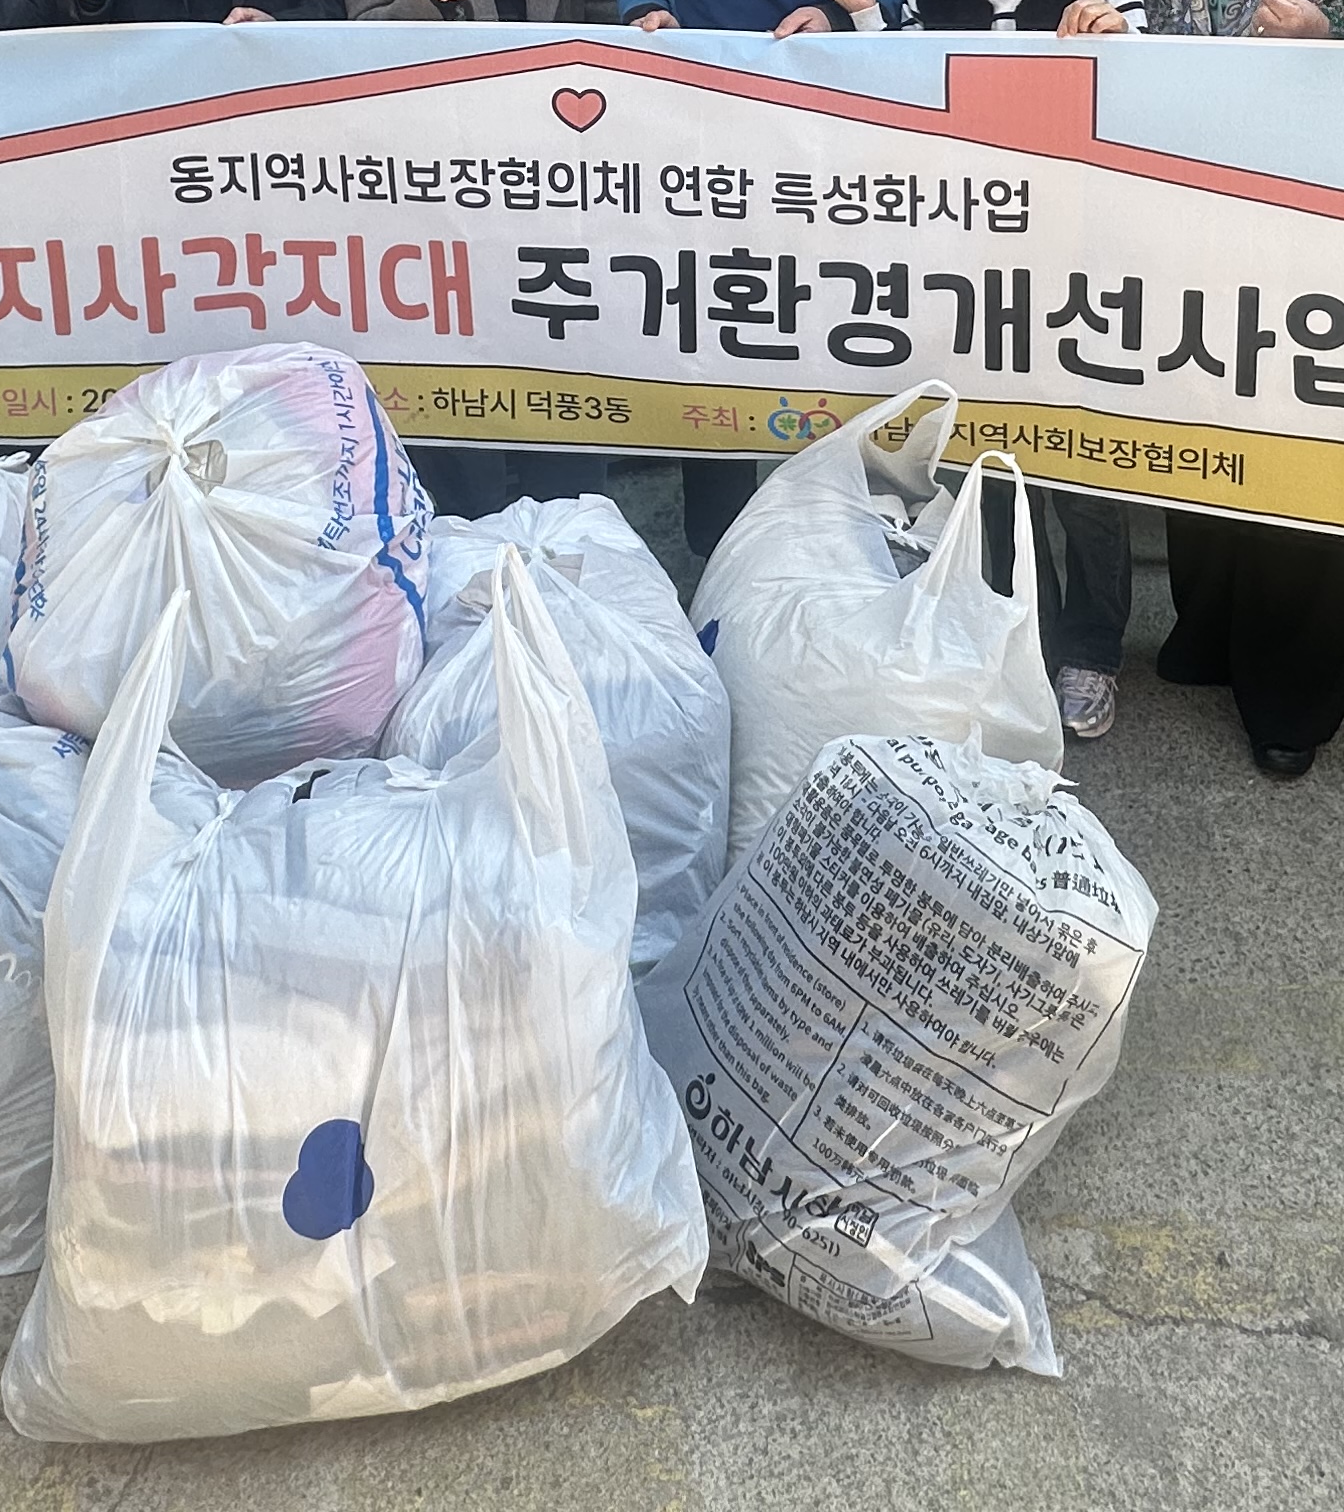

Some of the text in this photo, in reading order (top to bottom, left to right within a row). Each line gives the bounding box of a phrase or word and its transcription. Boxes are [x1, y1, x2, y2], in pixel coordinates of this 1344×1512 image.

[169, 151, 1033, 235] 동지역사회보장협의체 연합 특성화사업
[1, 384, 58, 419] 일시
[81, 385, 118, 418] 20
[373, 383, 411, 412] 소
[430, 385, 519, 420] 하남시
[524, 387, 634, 425] 덕풍3동
[680, 400, 742, 434] 주최
[765, 840, 939, 1008] 100만원 이하의 과태료가 부과됩니다.
[810, 819, 853, 865] 불가능한
[846, 855, 885, 895] 불연성
[956, 944, 1007, 988] 도자기,
[864, 798, 898, 833] 다음날
[917, 843, 968, 889] 6시까지
[963, 879, 1013, 924] 내집앞,
[1010, 914, 1082, 969] 내상가앞에
[933, 833, 1016, 901] 일반쓰레기만
[1080, 936, 1101, 957] 후
[768, 868, 798, 905] 봉투는
[790, 896, 820, 933] 하남시
[813, 925, 841, 954] 지역
[837, 946, 894, 998] 내에서만
[889, 990, 962, 1049] 사용하여야
[957, 1038, 1001, 1070] 합니다.
[810, 870, 835, 899] 다른
[828, 890, 857, 920] 봉투
[852, 911, 885, 943] 등을
[881, 934, 937, 983] 사용하여
[933, 974, 993, 1025] 쓰레기를
[817, 852, 863, 900] 스티커를
[857, 890, 912, 940] 이용하여
[908, 930, 967, 981] 배출하여
[961, 972, 1025, 1023] 주십시오.
[877, 858, 919, 898] 투명한
[913, 889, 959, 929] 봉투에
[955, 919, 988, 949] 담아
[983, 939, 1067, 1005] 분리배출하여
[724, 918, 743, 939] Sort
[760, 975, 781, 1003] items
[777, 996, 791, 1016] by
[788, 1009, 814, 1036] type
[810, 1029, 835, 1052] and
[748, 991, 794, 1045] separately.
[774, 961, 792, 987] from
[789, 982, 812, 1007] 6PM
[809, 1002, 823, 1017] to
[821, 1011, 849, 1038] 6AM.
[780, 941, 815, 983] residence
[811, 977, 848, 1012] (store)
[715, 1039, 737, 1065] than
[733, 1059, 753, 1084] this
[726, 1021, 762, 1065] disposal
[758, 1059, 771, 1074] of
[767, 1071, 800, 1102] waste
[747, 1019, 757, 1031] 1
[753, 1027, 788, 1062] million
[784, 1057, 805, 1079] will
[800, 1072, 817, 1092] be
